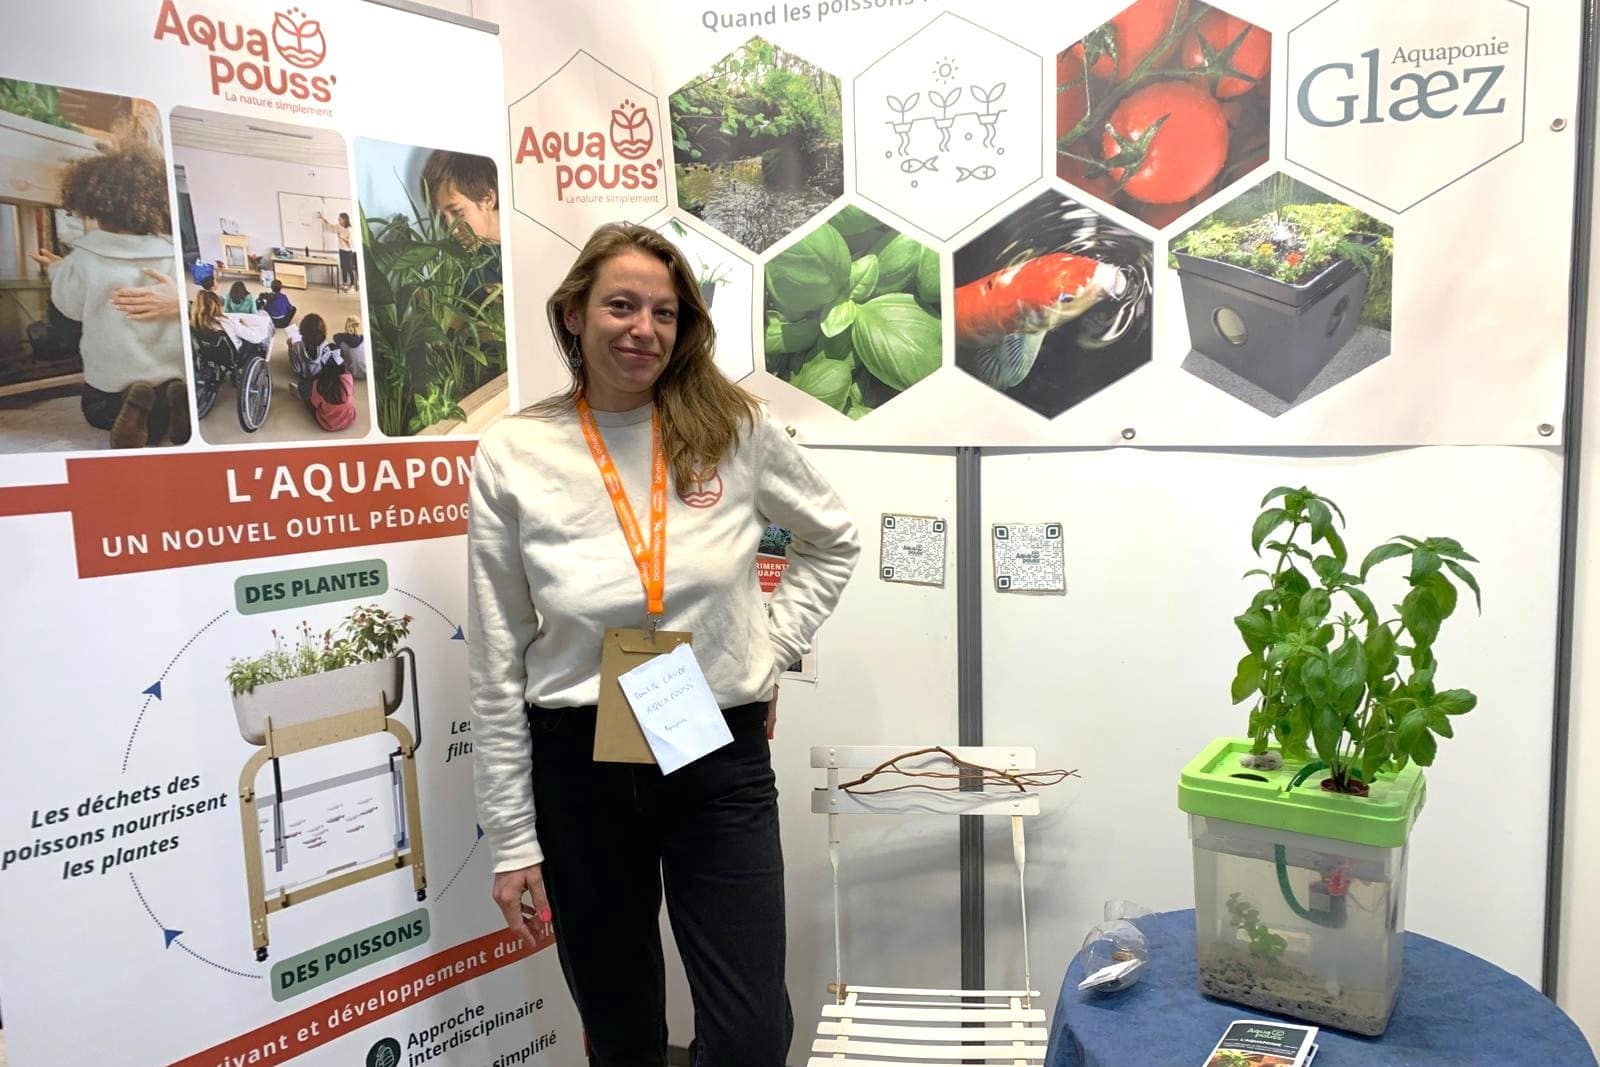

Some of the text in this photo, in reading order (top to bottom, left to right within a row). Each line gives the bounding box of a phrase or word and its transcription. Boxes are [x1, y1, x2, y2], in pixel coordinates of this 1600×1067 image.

[702, 5, 776, 32] Quand
[783, 4, 811, 23] les
[1391, 36, 1510, 67] Aquaponie
[224, 91, 333, 117] La nature simplement
[576, 193, 604, 203] nature
[605, 193, 658, 205] simplement
[102, 535, 149, 558] UN
[162, 523, 277, 552] NOUVEL
[286, 511, 361, 538] OUTIL
[245, 569, 381, 604] DES PLANTES
[31, 774, 201, 829] Les déchets des
[0, 792, 228, 871] poissons nourrissent
[62, 834, 180, 880] les plantes
[280, 919, 424, 990] DES POISSONS
[216, 1034, 289, 1067] ivant
[297, 1021, 320, 1042] et
[327, 949, 488, 1029] développement
[406, 1003, 485, 1049] Approche
[408, 997, 544, 1067] interdisciplinaire
